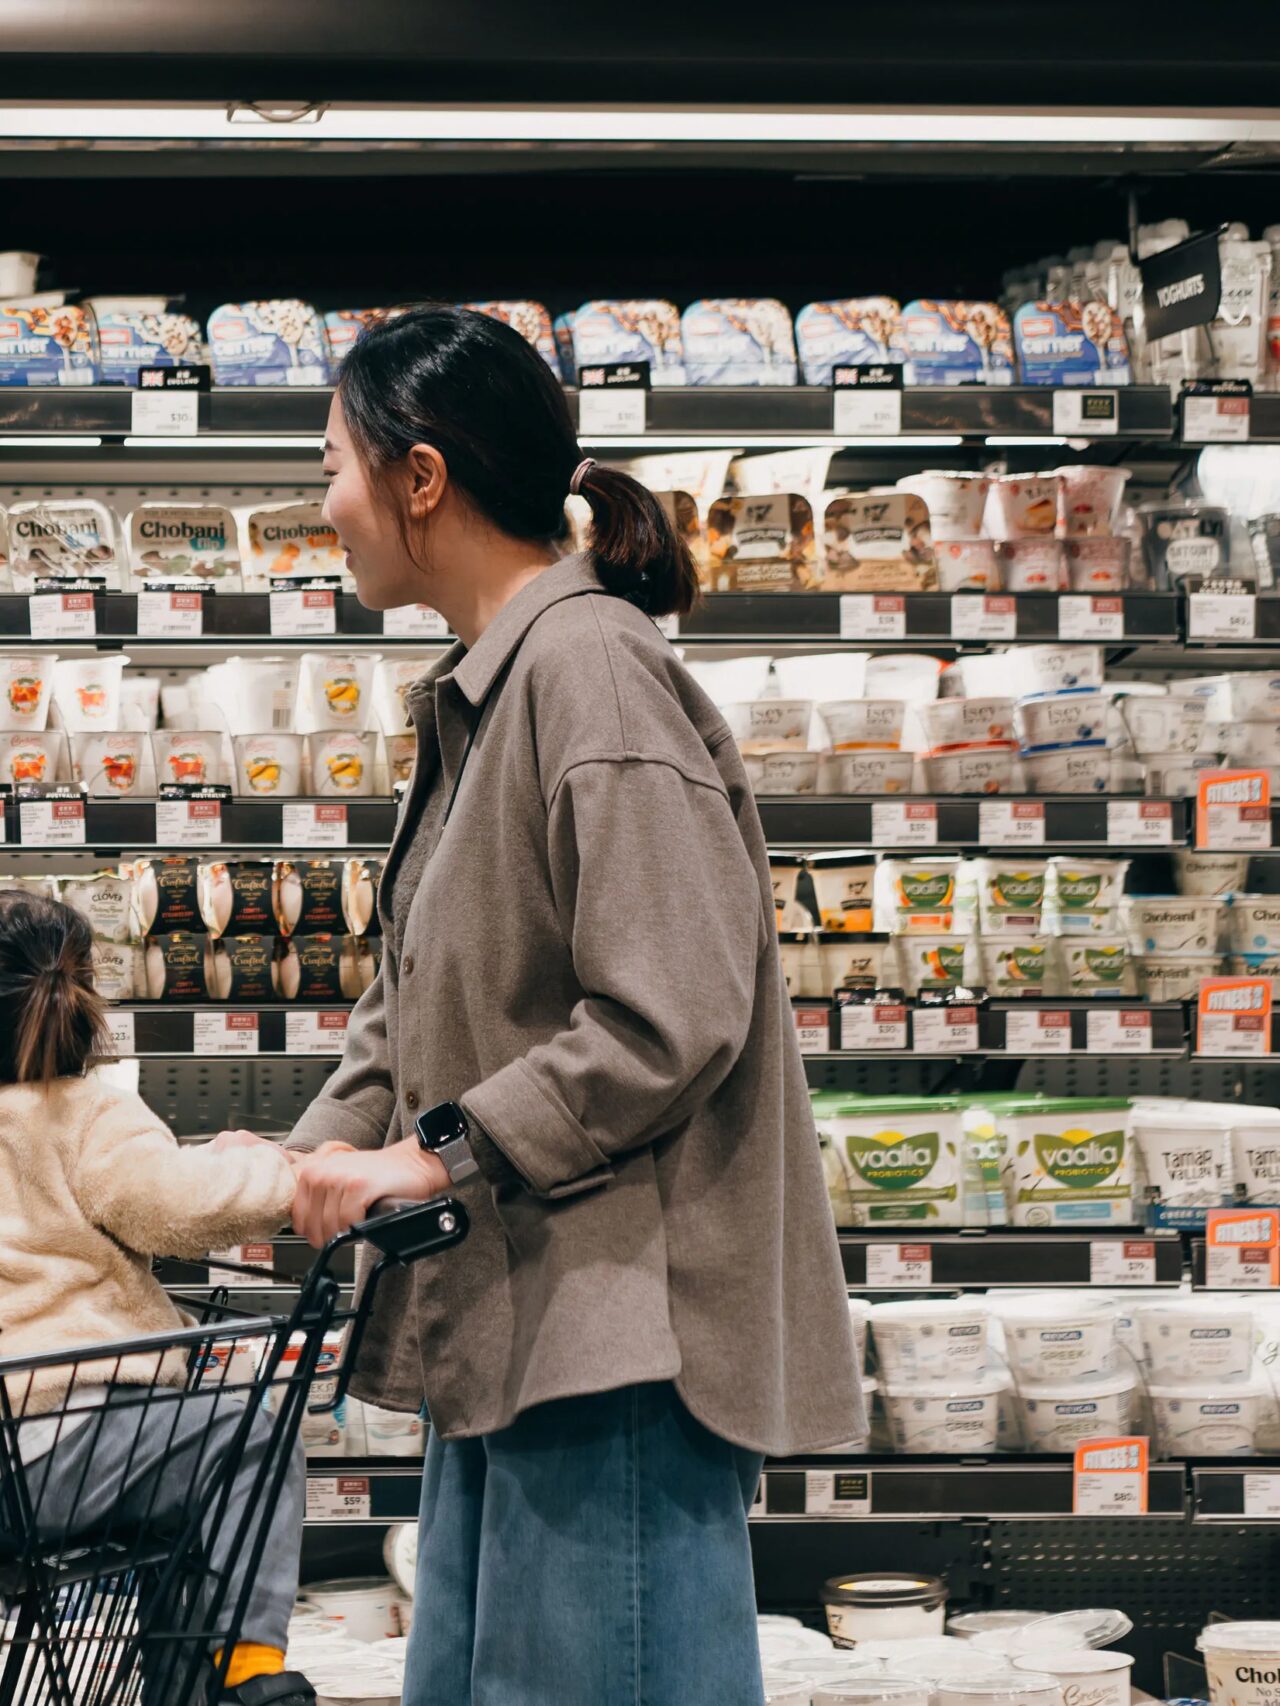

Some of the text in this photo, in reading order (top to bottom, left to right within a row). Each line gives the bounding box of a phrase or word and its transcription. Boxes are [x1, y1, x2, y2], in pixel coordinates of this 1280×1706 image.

[1157, 273, 1206, 308] YOGHURTS
[167, 376, 199, 385] ENGLAND
[16, 518, 98, 538] Chobani
[140, 520, 226, 539] Chobani
[46, 791, 81, 800] AUSTRALIA
[157, 876, 195, 890] Crafted
[231, 877, 268, 891] Crafted
[301, 877, 337, 890] Crafted
[92, 892, 123, 902] CLOVER
[1143, 909, 1195, 923] Chobani
[164, 953, 202, 965] Crafted
[231, 954, 268, 967] Crafted
[300, 954, 336, 967] Crafted
[852, 1141, 932, 1168] vaalia
[1040, 1141, 1118, 1167] vaalia
[866, 1168, 924, 1179] PROBIOTICS
[1053, 1167, 1111, 1177] PROBIOTICS
